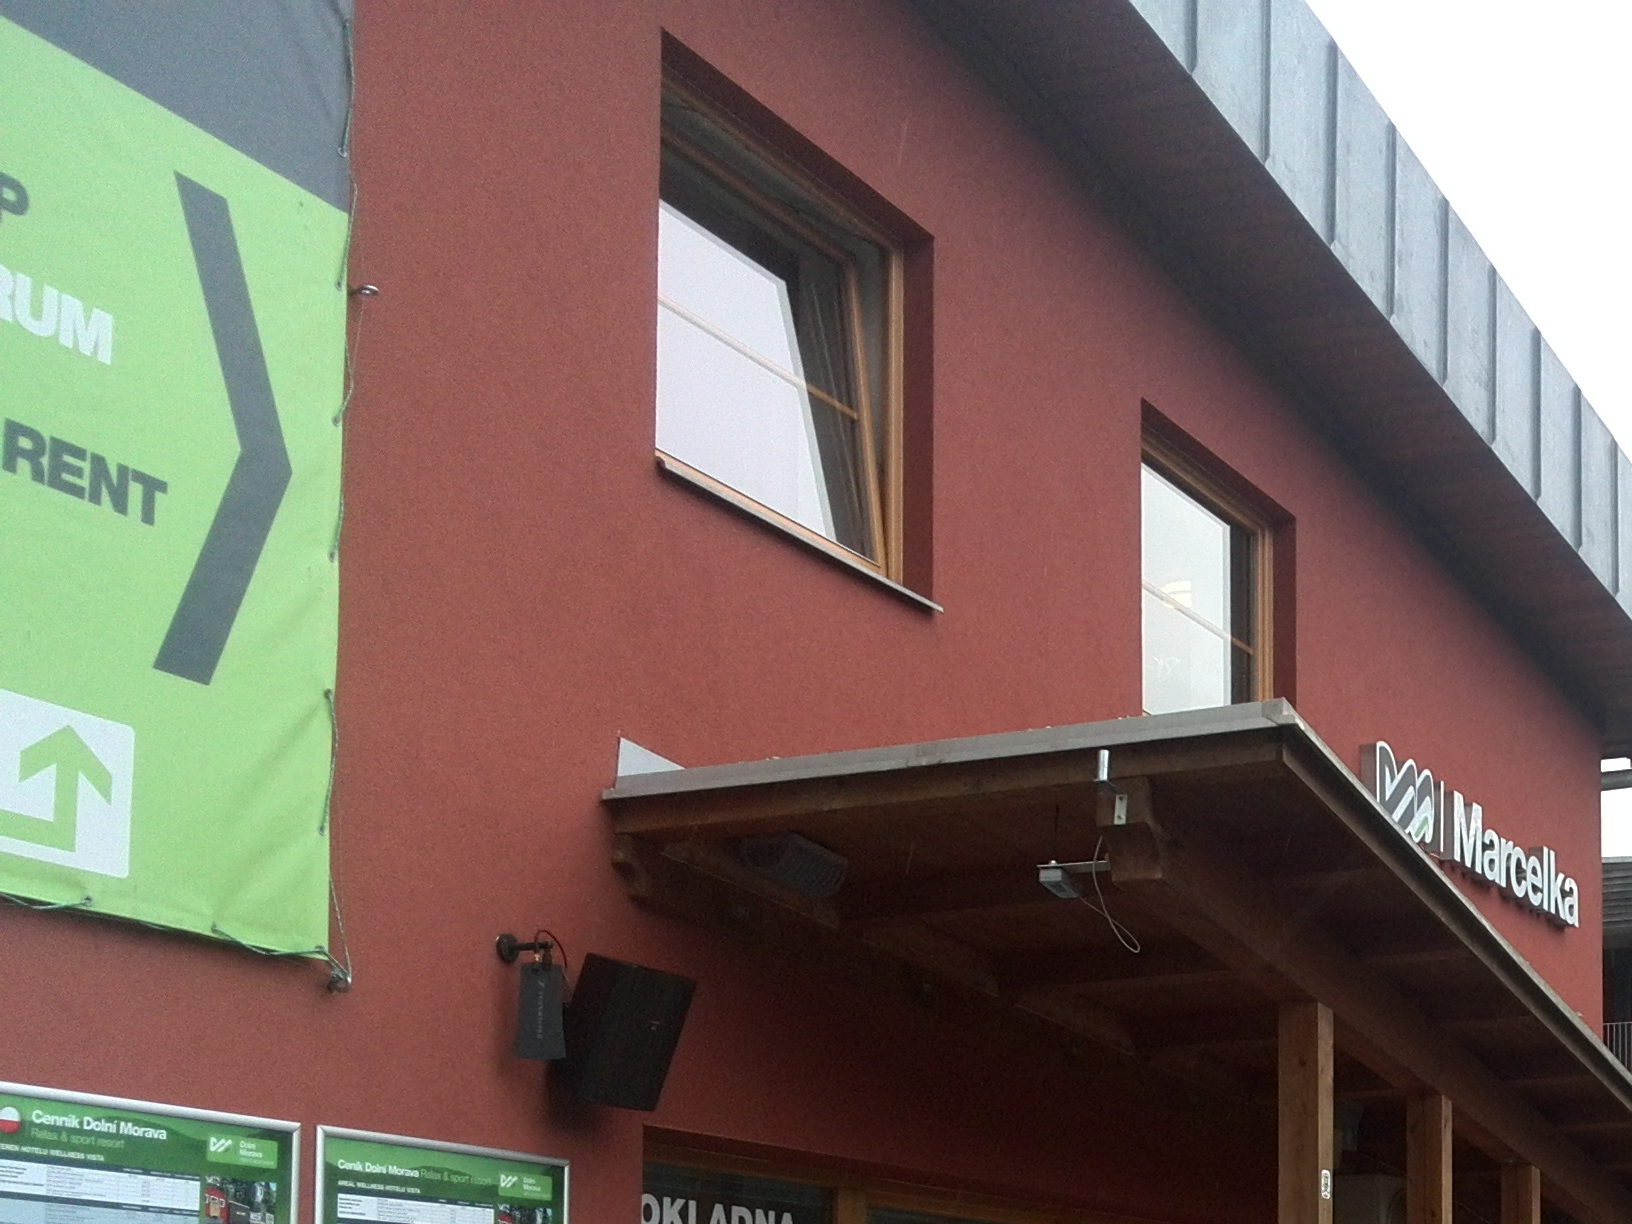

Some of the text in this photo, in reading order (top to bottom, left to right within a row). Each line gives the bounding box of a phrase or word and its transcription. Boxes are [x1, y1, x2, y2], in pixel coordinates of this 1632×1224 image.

[2, 417, 168, 527] RENT
[1453, 790, 1579, 928] Marcelka
[83, 1116, 117, 1133] Dolní
[120, 1121, 167, 1140] Morava
